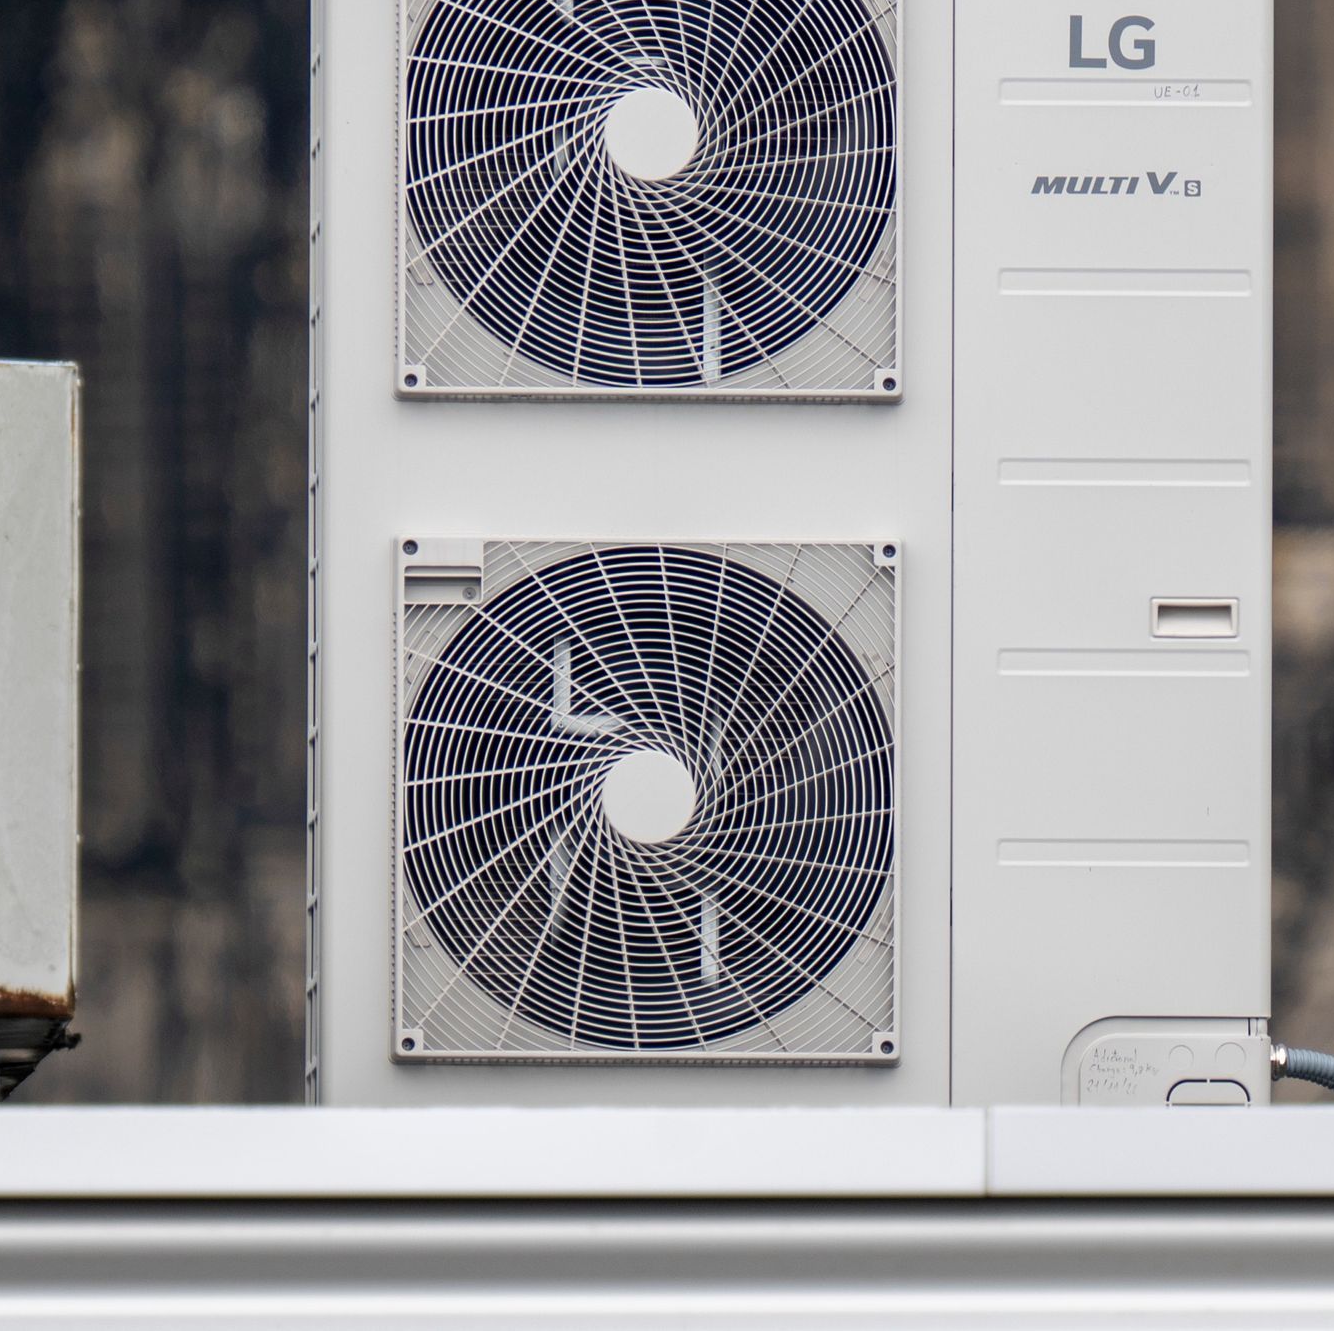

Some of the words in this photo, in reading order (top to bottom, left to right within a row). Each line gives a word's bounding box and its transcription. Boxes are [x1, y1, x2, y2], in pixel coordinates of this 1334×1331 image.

[1069, 15, 1156, 70] LG
[1031, 176, 1139, 195] MULTI
[1186, 181, 1200, 196] S
